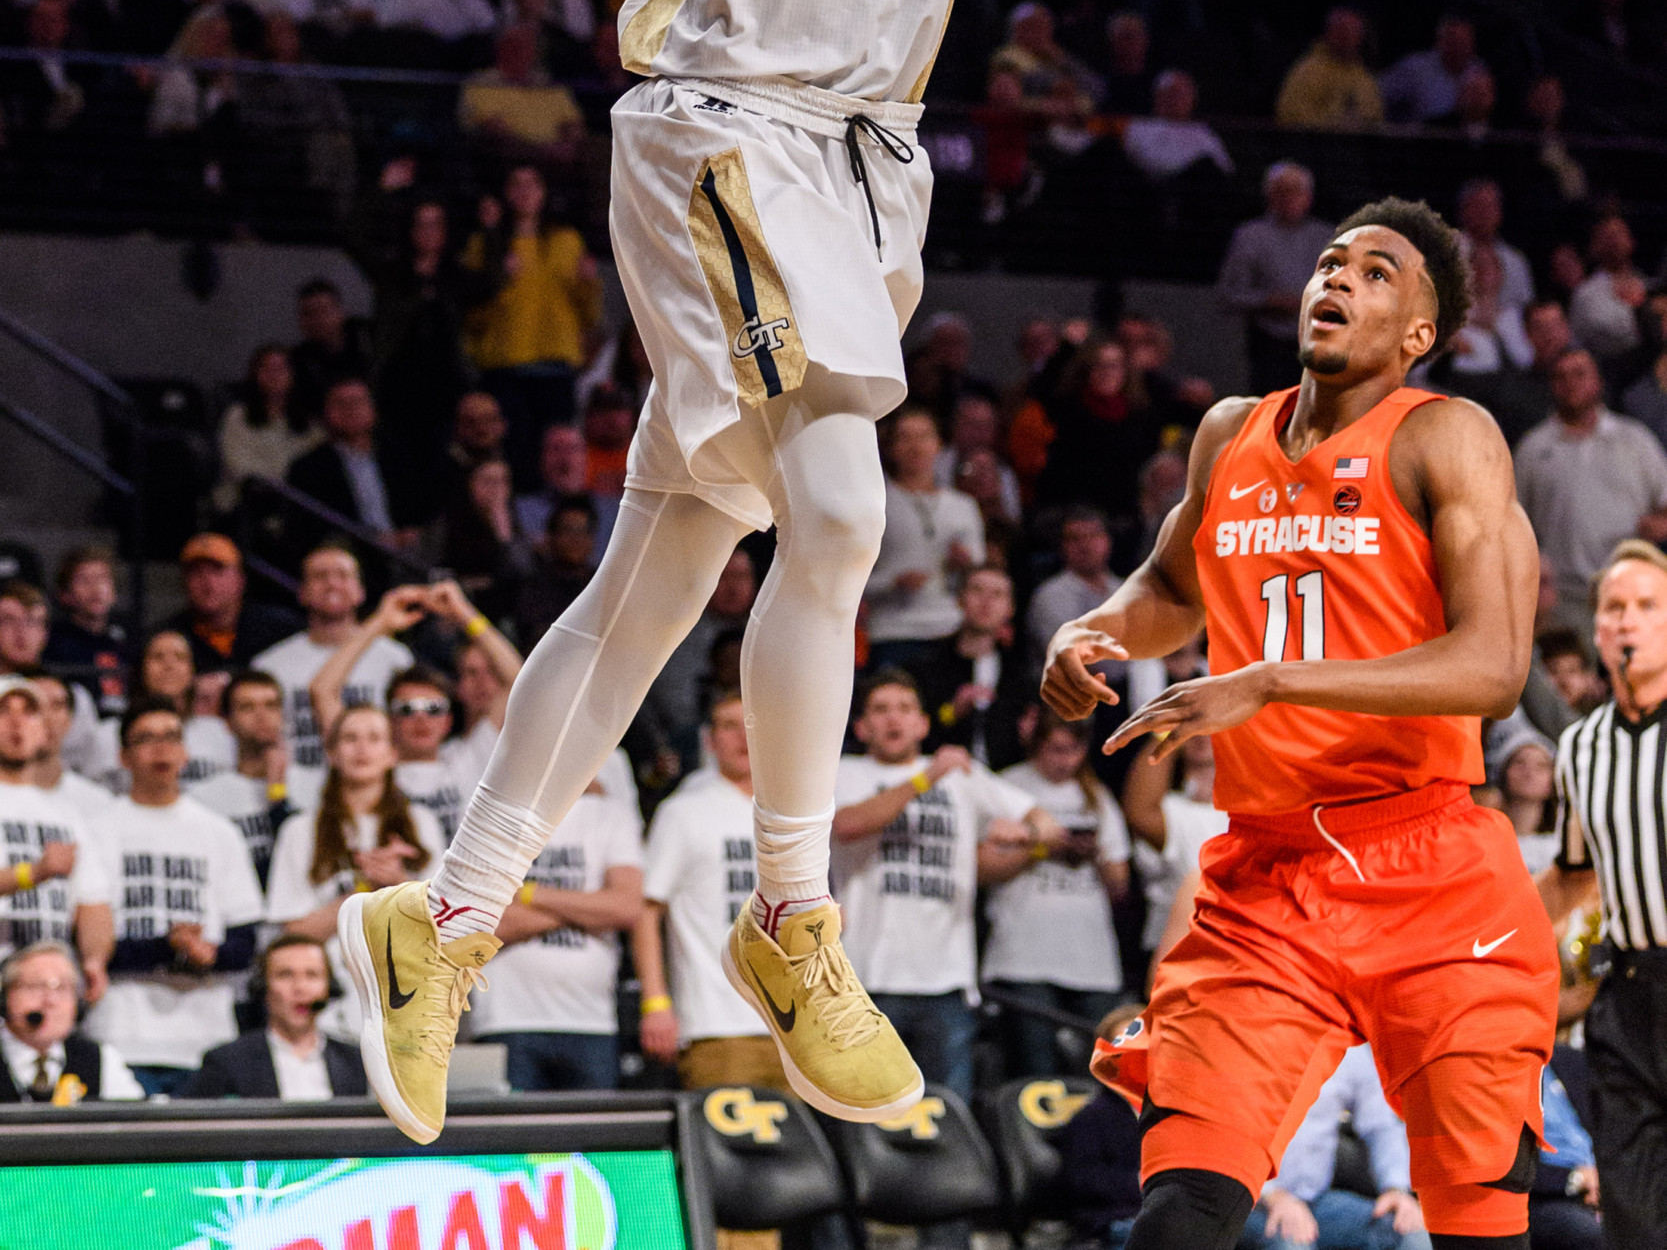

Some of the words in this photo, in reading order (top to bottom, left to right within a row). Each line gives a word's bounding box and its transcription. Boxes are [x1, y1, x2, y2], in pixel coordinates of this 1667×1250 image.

[732, 316, 790, 359] GT
[1215, 515, 1380, 558] SYRACUSE
[1261, 570, 1325, 663] 11
[703, 1087, 788, 1143] GT
[876, 1097, 946, 1140] T
[1019, 1080, 1092, 1129] G
